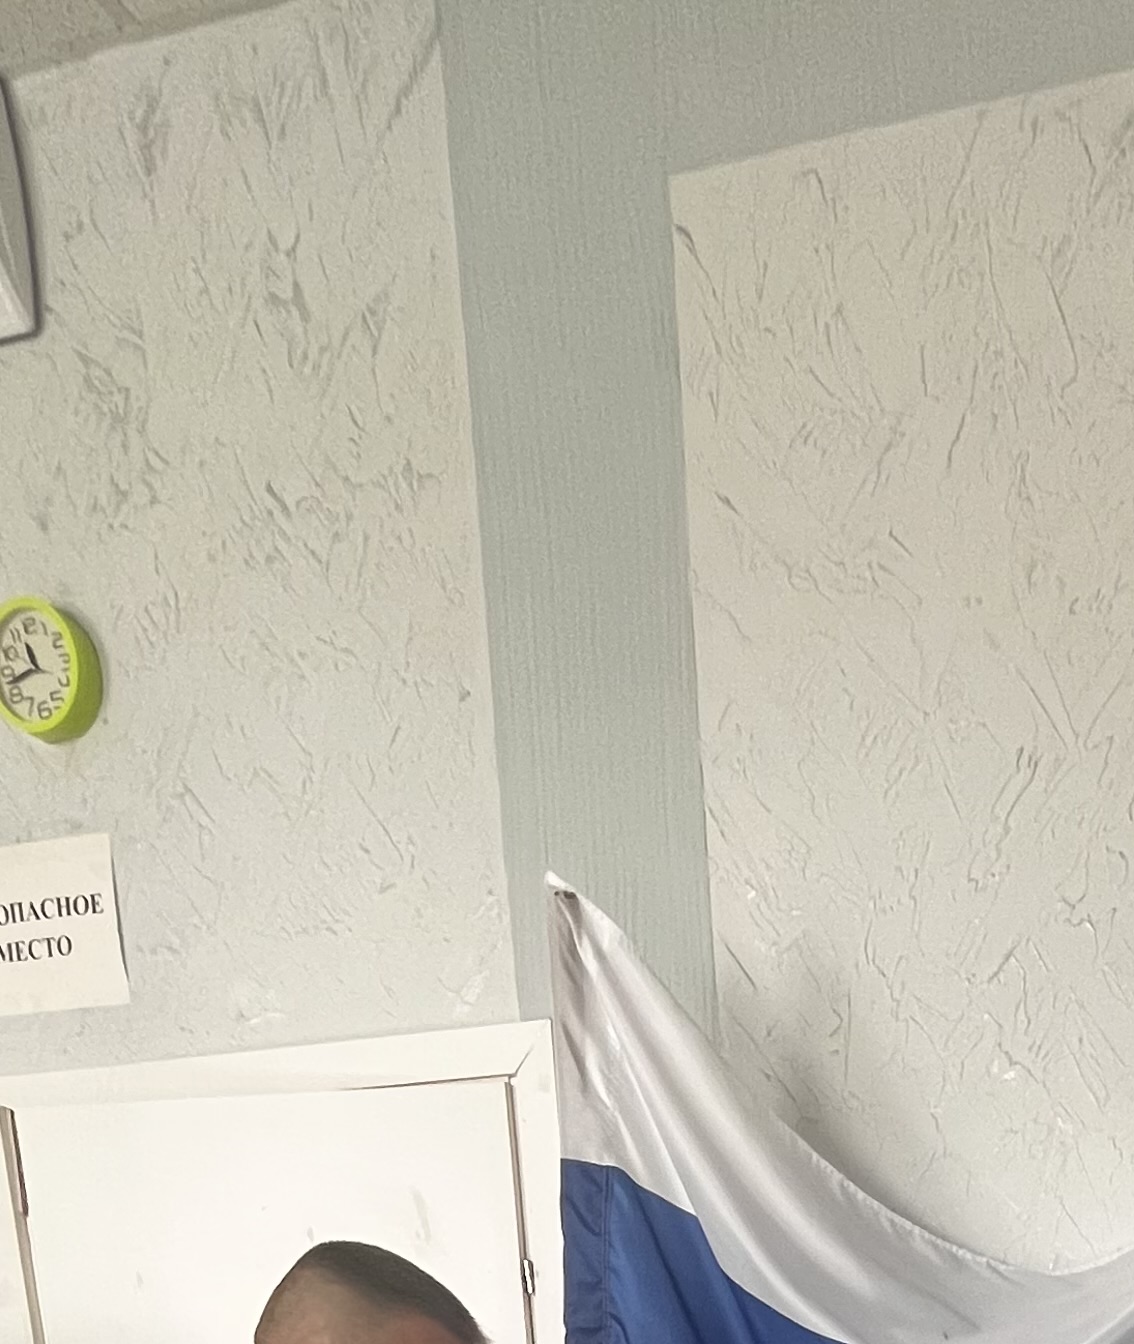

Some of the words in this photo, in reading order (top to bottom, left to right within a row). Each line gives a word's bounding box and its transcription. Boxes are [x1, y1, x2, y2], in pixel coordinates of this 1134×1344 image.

[52, 632, 64, 649] 2
[9, 685, 24, 704] 8
[49, 691, 65, 709] 5
[23, 696, 34, 717] 7
[37, 700, 52, 720] 6
